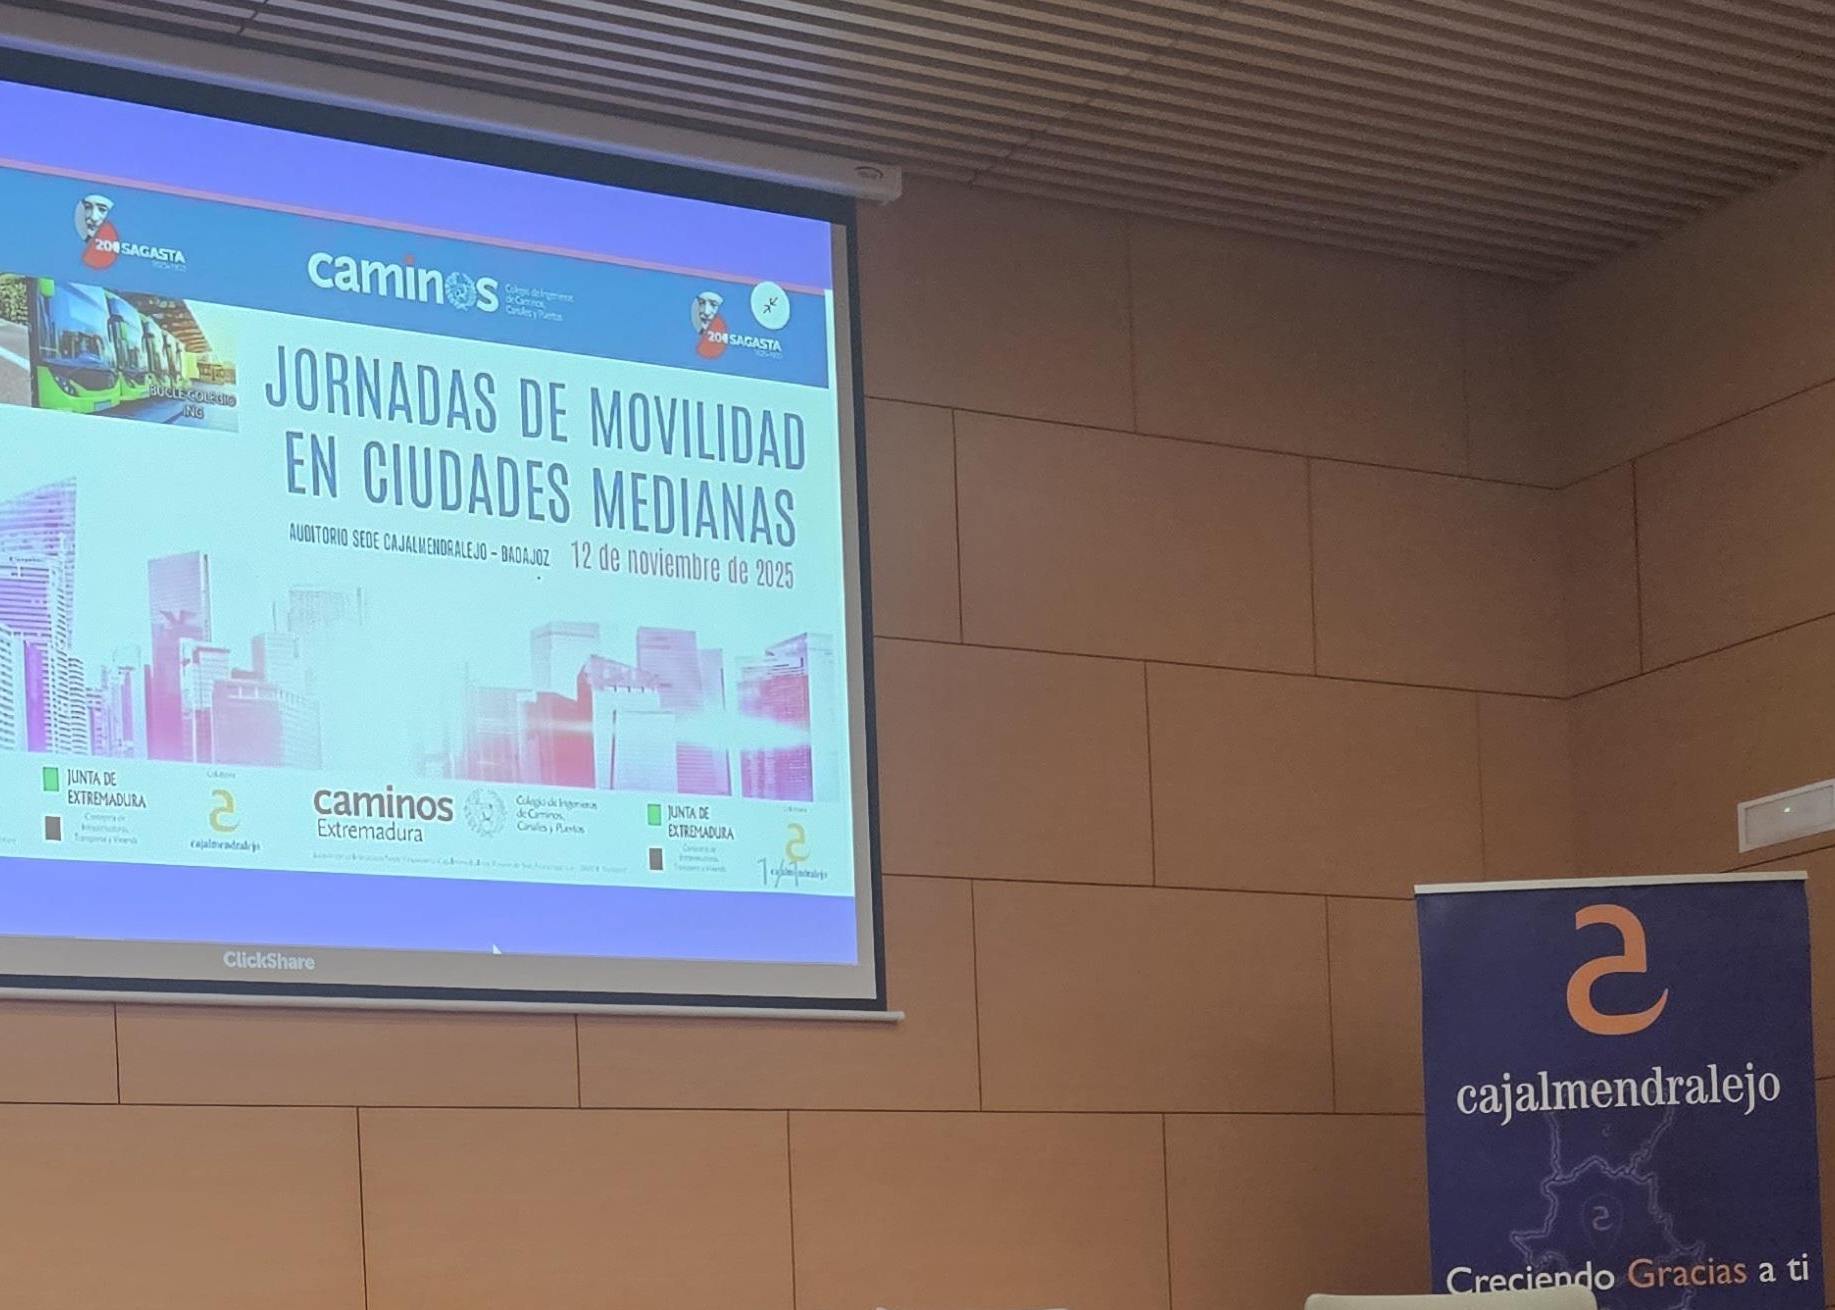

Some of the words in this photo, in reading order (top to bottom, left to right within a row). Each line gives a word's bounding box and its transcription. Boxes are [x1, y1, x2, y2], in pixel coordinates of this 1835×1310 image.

[121, 241, 186, 264] SAGASTA
[730, 334, 782, 352] SAGASTA
[266, 346, 496, 433] JORNADAS
[520, 378, 568, 442] DE
[591, 387, 805, 470] MOVILIDAD
[285, 432, 338, 498] EN
[365, 441, 570, 524] CIUDADES
[593, 468, 796, 547] MEDIANAS
[289, 523, 348, 546] AUDITORIO
[352, 531, 379, 550] SEDE
[383, 533, 487, 560] CAJALMENDRALEJO
[501, 545, 550, 567] BADAJOZ
[571, 540, 592, 569] 12
[599, 543, 620, 572] de
[628, 547, 720, 582] noviembre
[728, 556, 748, 584] de
[756, 558, 794, 589] 2025
[67, 769, 100, 786] JUNTA
[104, 770, 117, 786] DE
[68, 790, 147, 809] EXTREMADURA
[314, 785, 454, 822] caminos
[668, 805, 697, 820] JUNTA
[699, 807, 709, 820] DE
[318, 819, 423, 843] Extremadura
[669, 824, 734, 840] EXTREMADURA
[223, 951, 315, 970] ClickShare
[1457, 1062, 1781, 1126] cajalmendralejo
[1446, 1261, 1615, 1294] Creciendo
[1627, 1257, 1746, 1289] Gracias
[1758, 1262, 1776, 1282] a
[1787, 1254, 1809, 1282] ti
